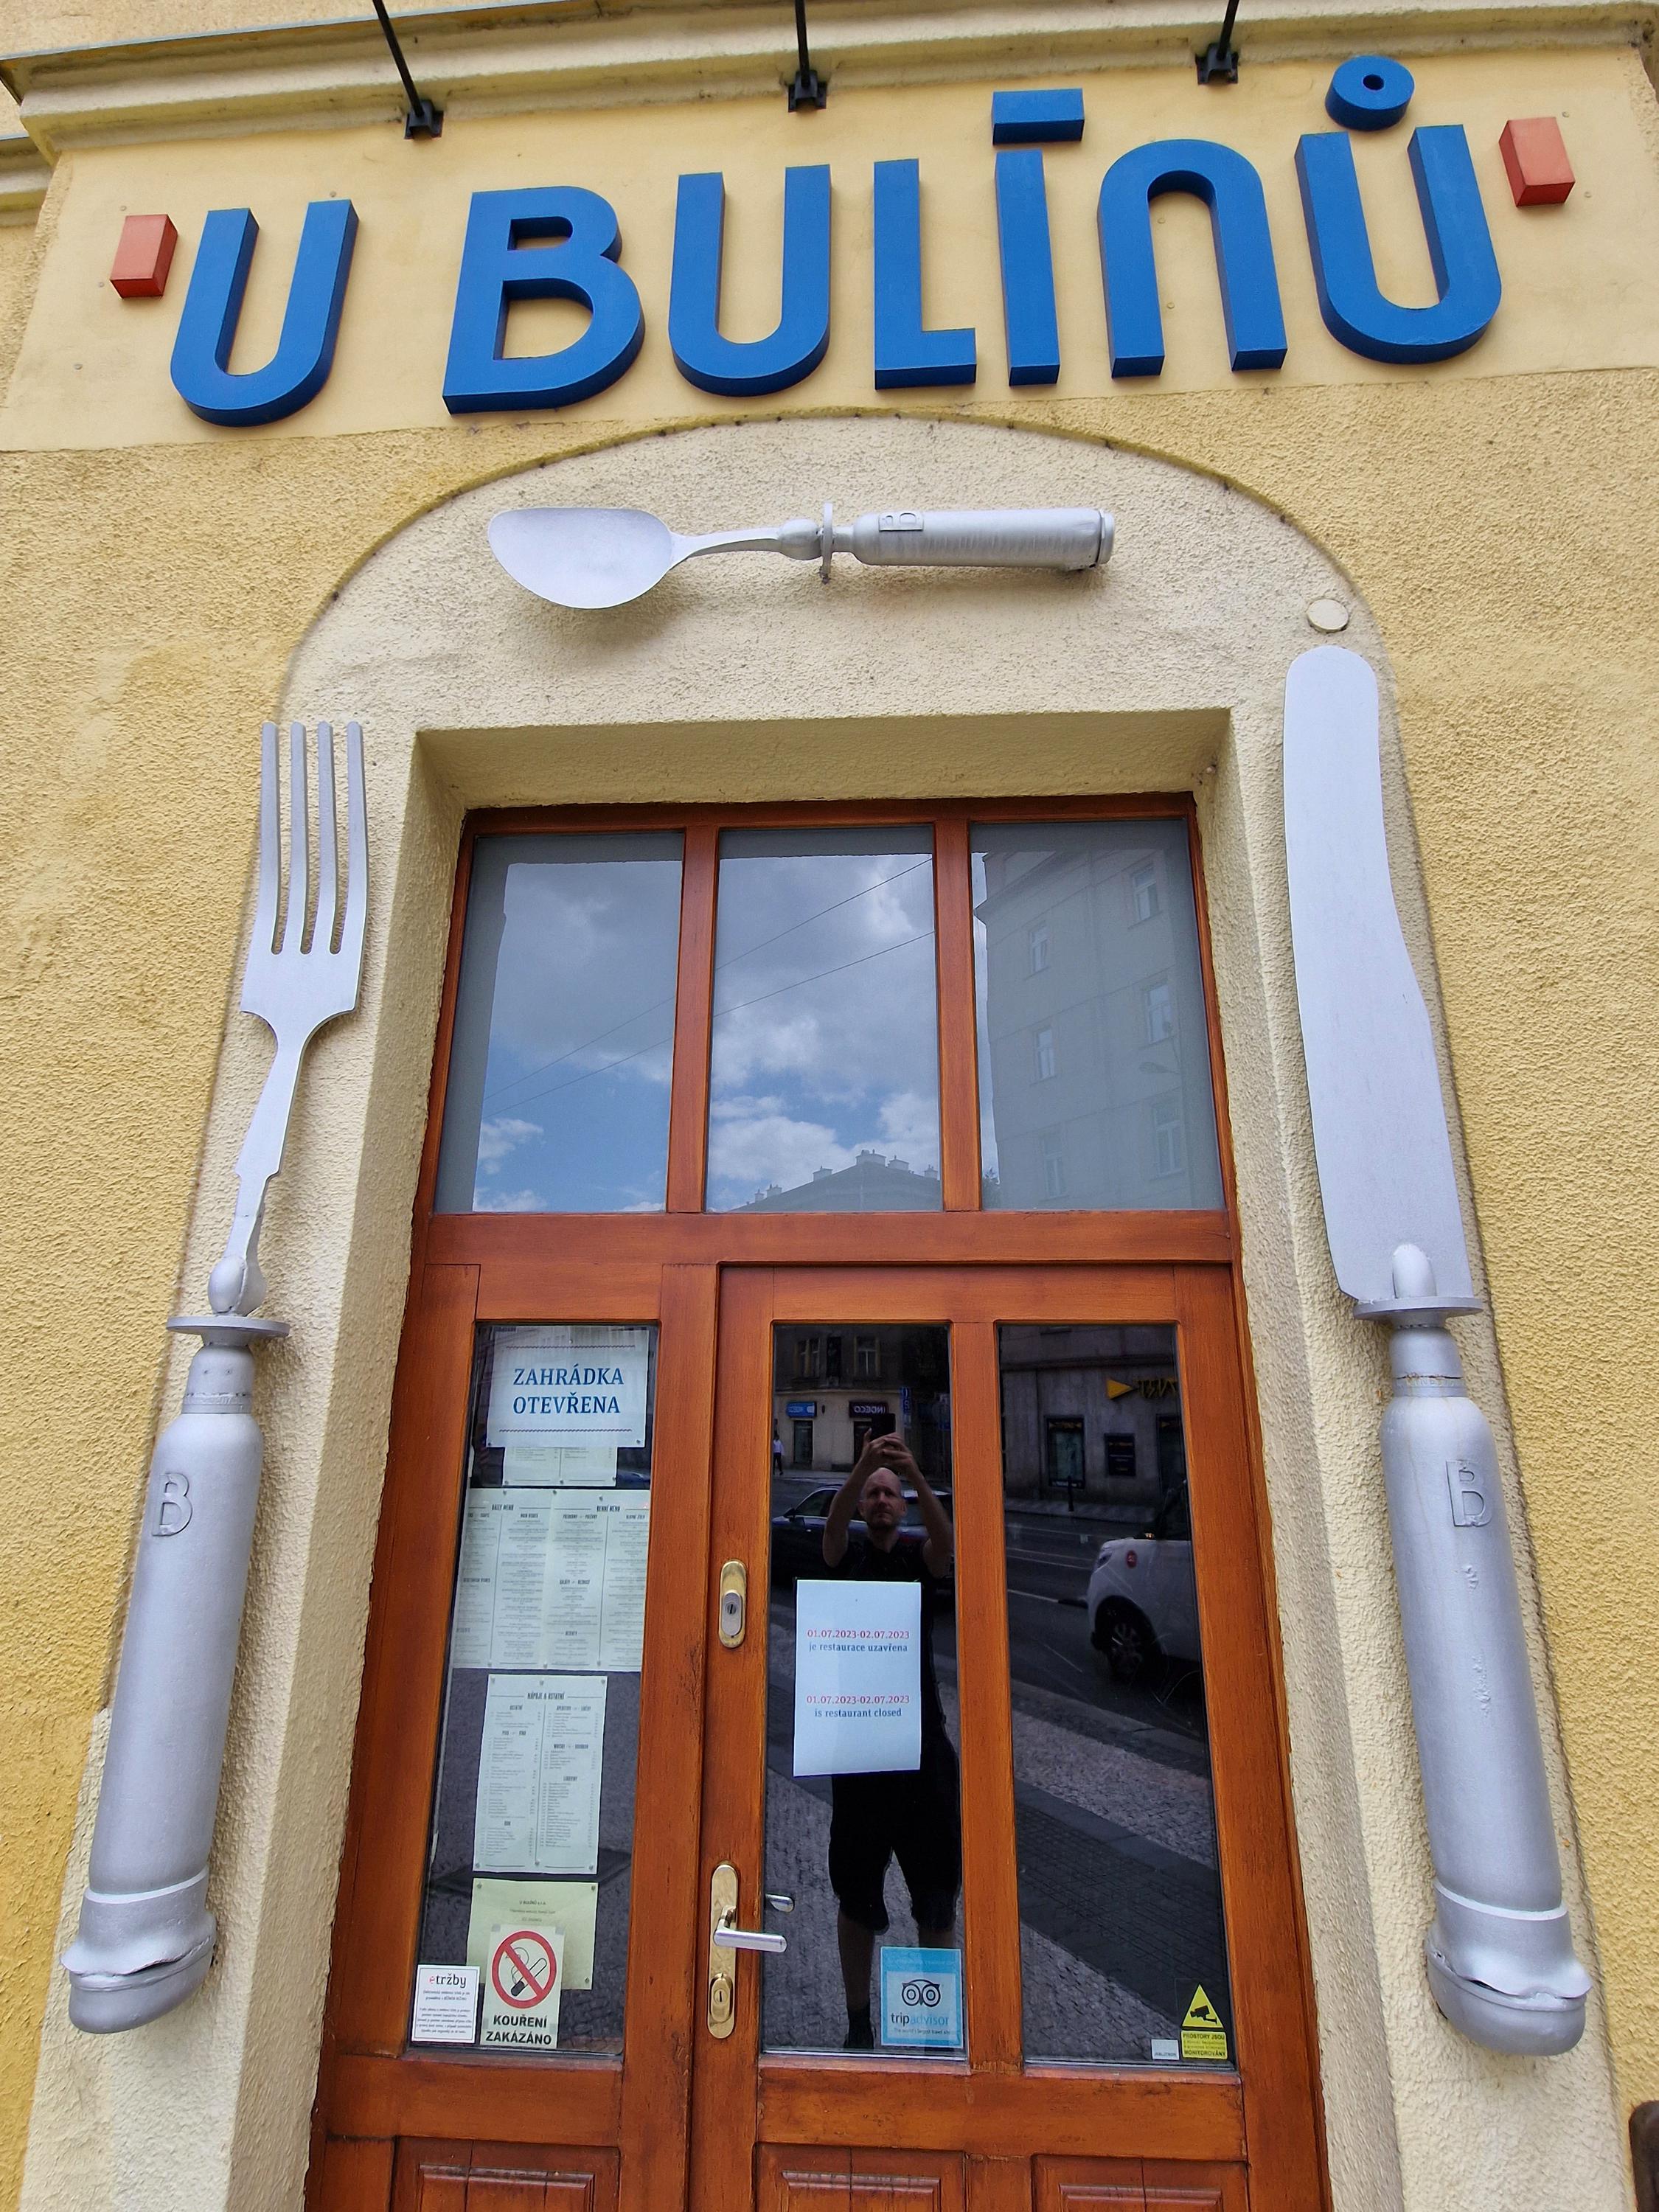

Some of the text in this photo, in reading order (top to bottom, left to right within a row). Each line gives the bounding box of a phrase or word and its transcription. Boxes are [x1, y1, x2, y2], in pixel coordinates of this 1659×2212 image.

[170, 198, 360, 428] U
[513, 1363, 624, 1385] ZAHRÁDKA
[513, 1391, 620, 1414] OTEVŘENA
[1445, 1459, 1493, 1527] B
[150, 1472, 193, 1537] B
[809, 1642, 908, 1652] je restaurace uzavřena
[815, 1708, 902, 1718] is restaurant closed
[429, 1973, 467, 1989] etržby
[493, 2014, 547, 2028] KOUŘENÍ
[891, 2012, 949, 2027] tripadvisor
[486, 2030, 552, 2045] ZAKÁZÁNO
